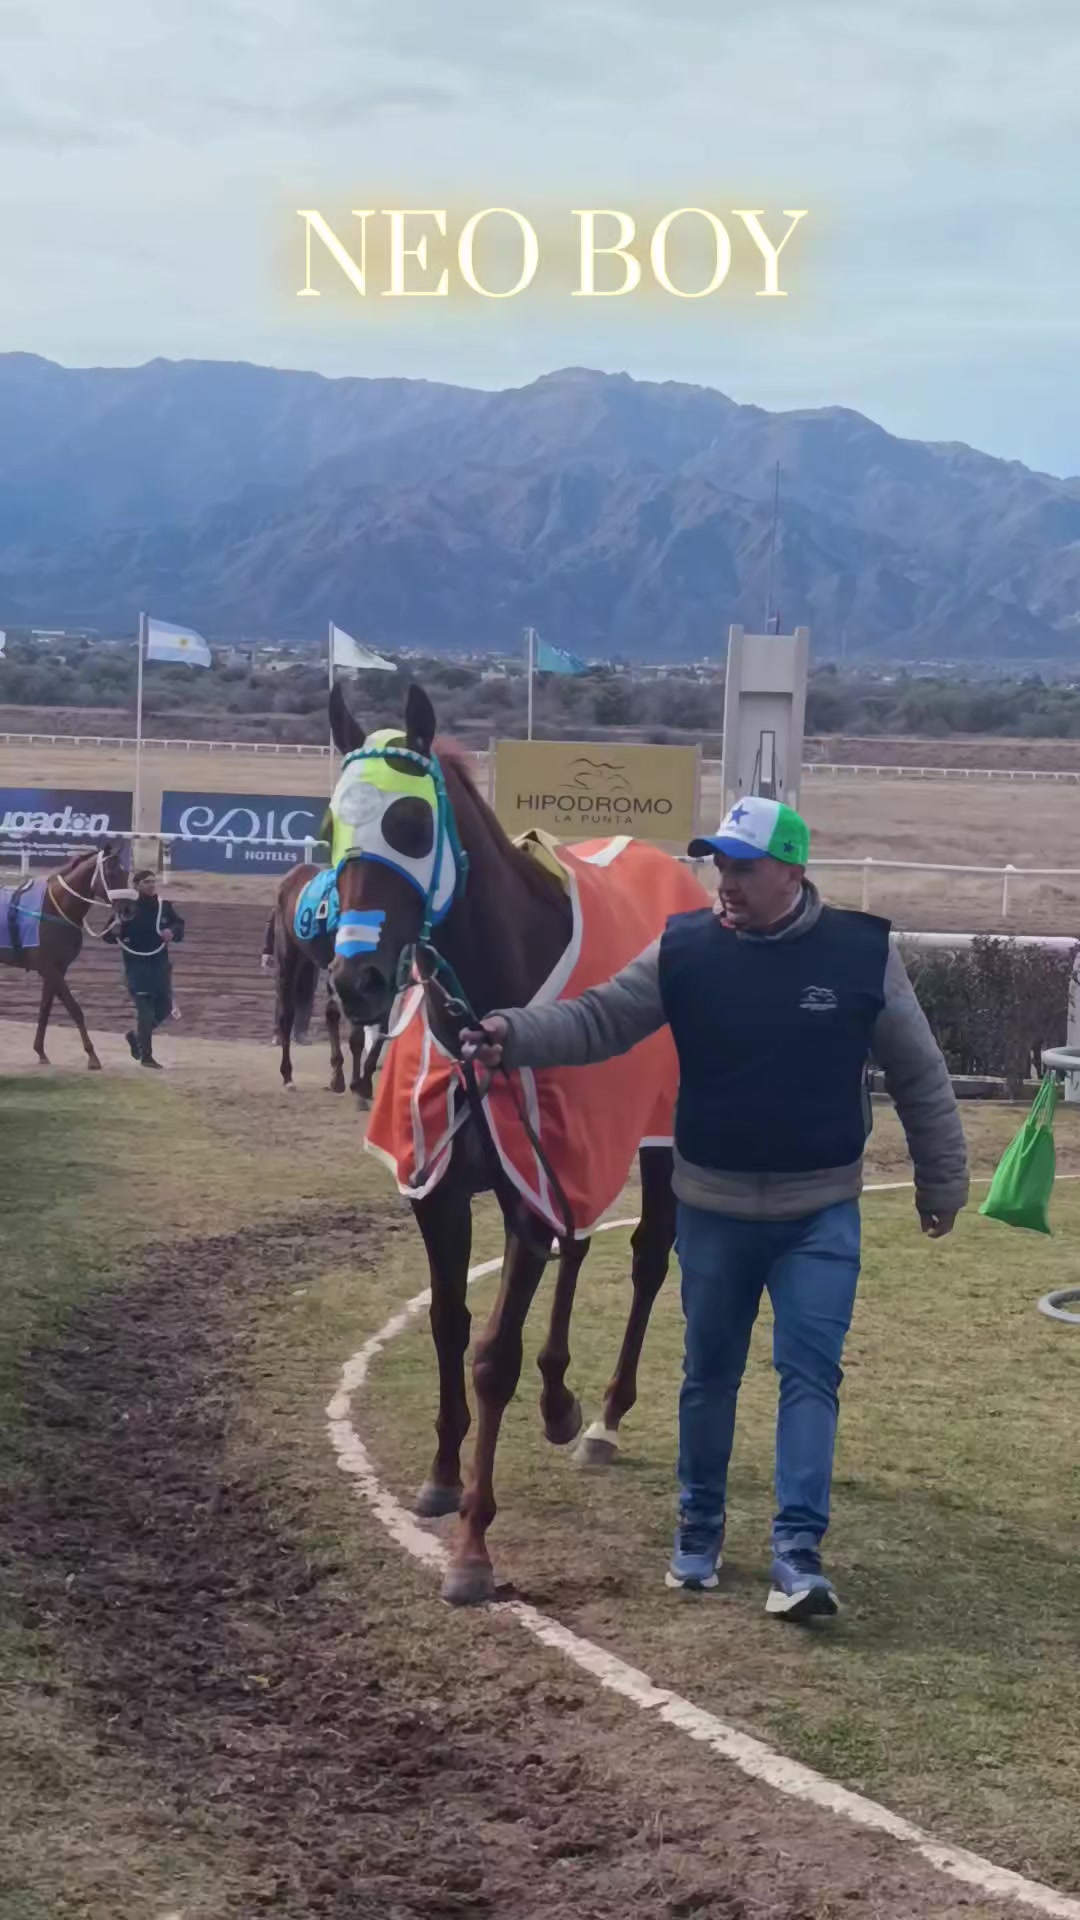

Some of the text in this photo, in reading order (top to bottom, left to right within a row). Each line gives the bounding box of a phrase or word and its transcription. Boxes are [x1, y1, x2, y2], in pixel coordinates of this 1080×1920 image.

[516, 794, 673, 814] HIPODROMO
[554, 814, 633, 824] LA PUNTA
[245, 850, 298, 862] HOTELES
[300, 907, 313, 938] 9
